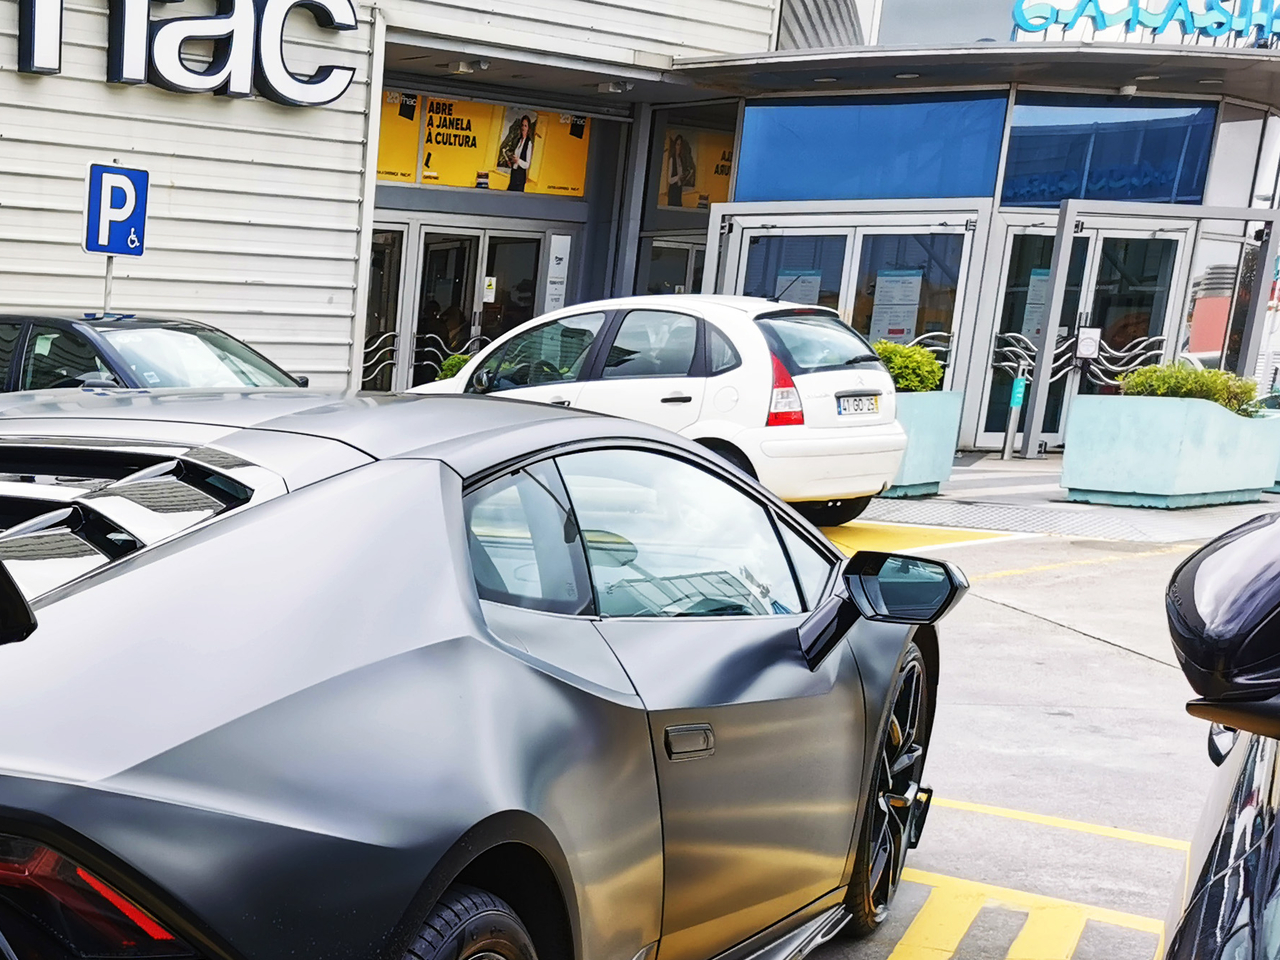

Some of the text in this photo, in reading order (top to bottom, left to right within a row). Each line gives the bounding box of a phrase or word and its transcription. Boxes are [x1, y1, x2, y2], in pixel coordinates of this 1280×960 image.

[1013, 0, 1280, 38] GAIASH
[428, 101, 454, 116] ABRE
[427, 115, 472, 132] A JANELA
[435, 132, 477, 148] CULTURA
[98, 172, 137, 247] P
